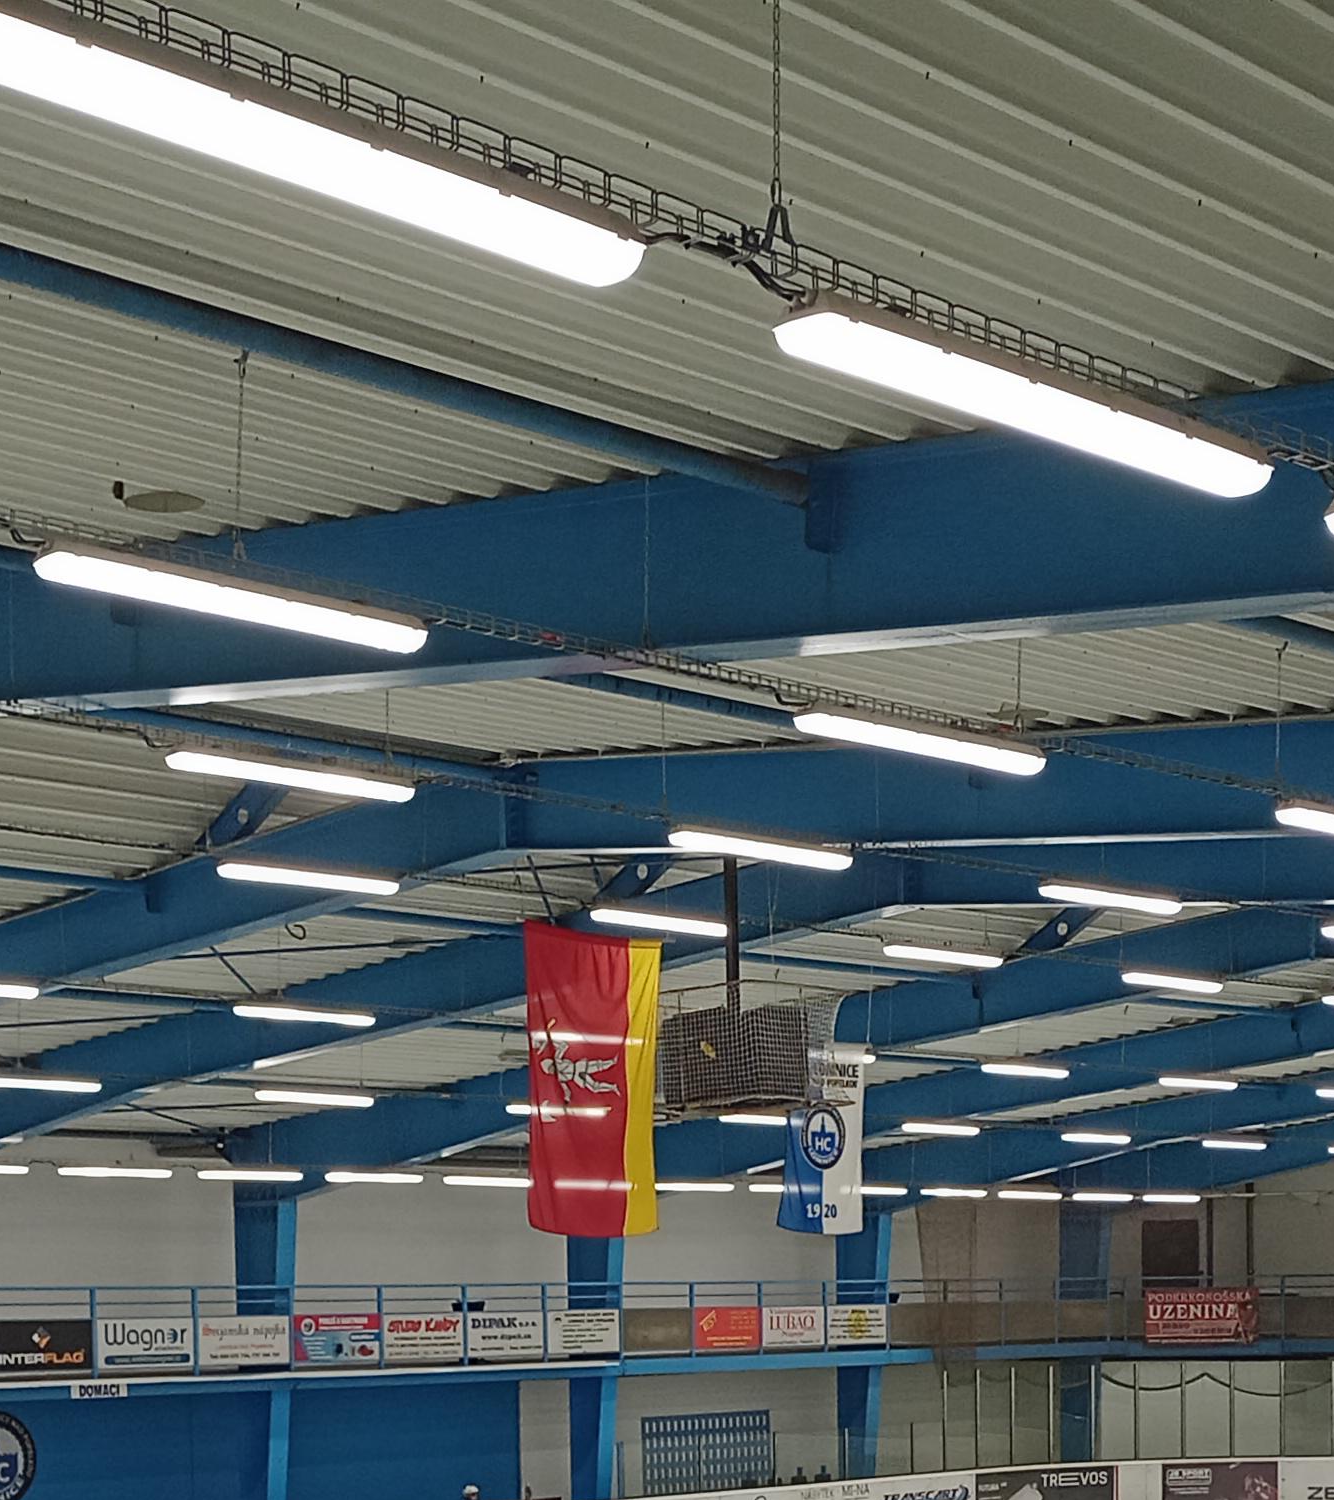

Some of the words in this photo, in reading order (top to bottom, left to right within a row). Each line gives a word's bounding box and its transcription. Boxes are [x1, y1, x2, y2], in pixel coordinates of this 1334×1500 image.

[815, 1137, 831, 1151] HC
[1148, 1303, 1239, 1320] UZENINA
[471, 1317, 517, 1329] DIPAK
[0, 1351, 85, 1365] INTERFLAG
